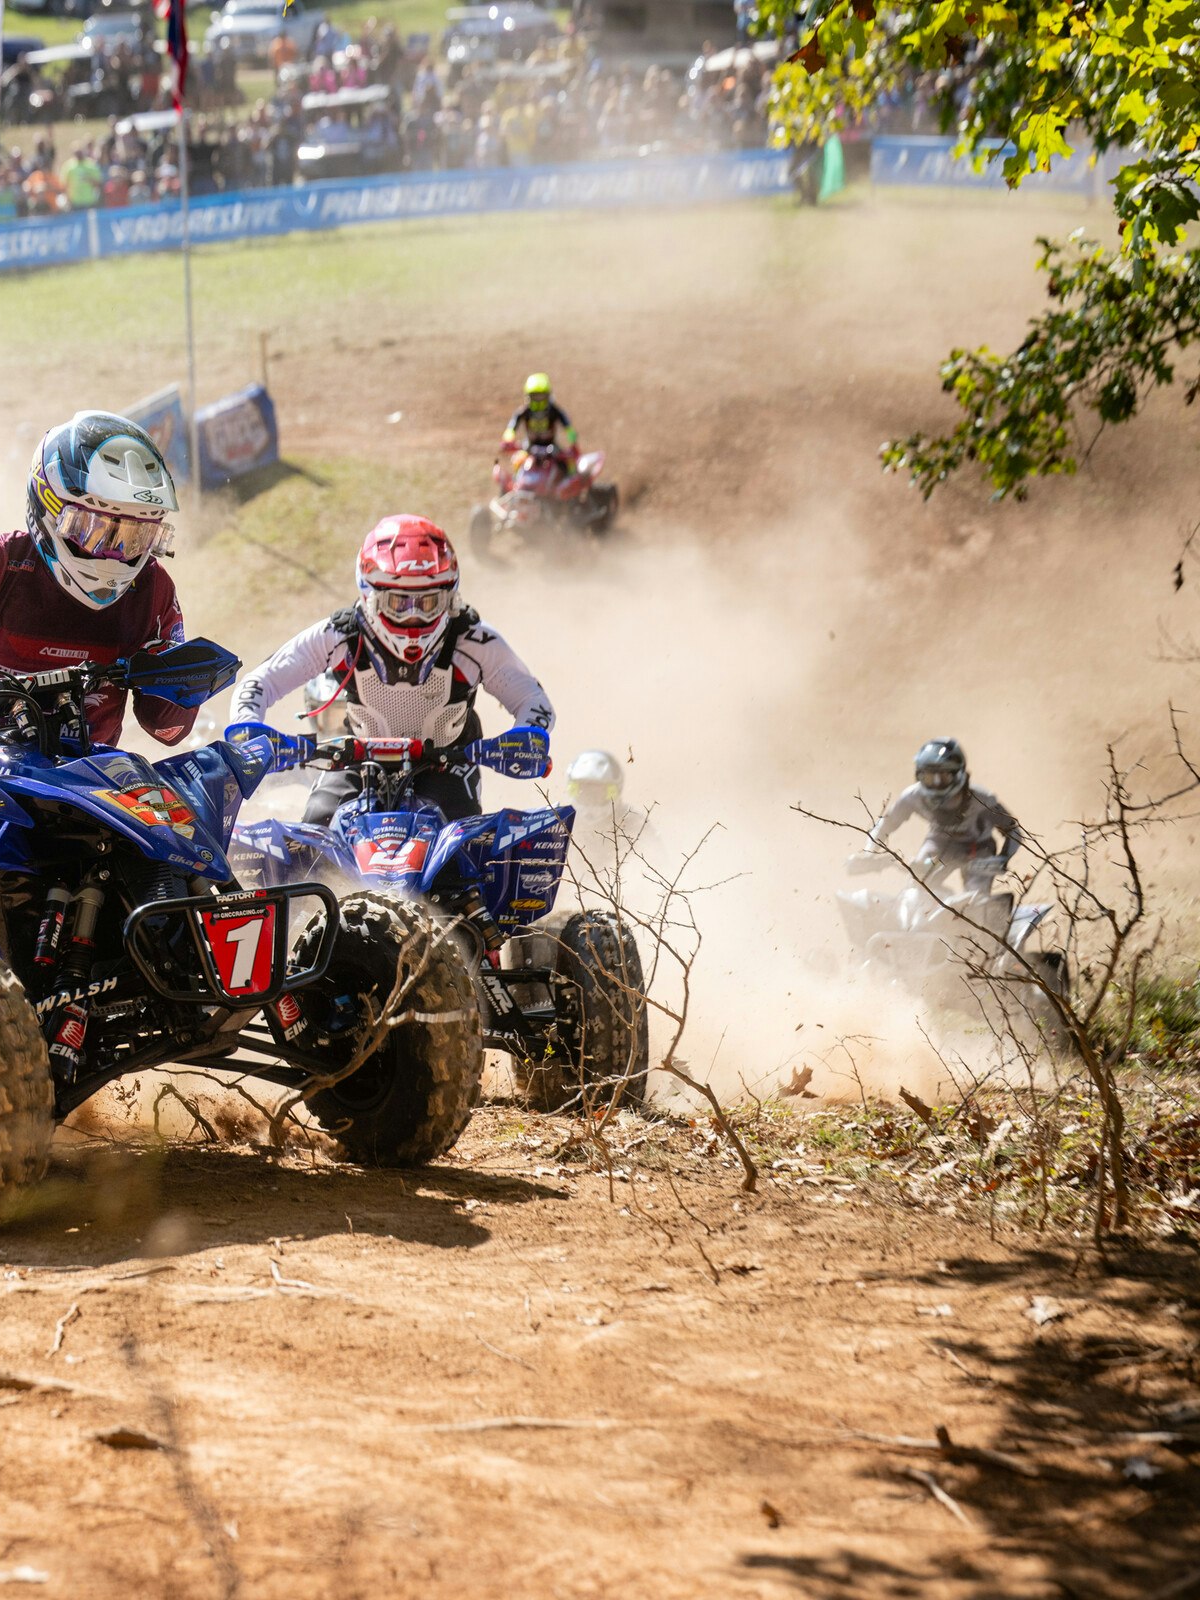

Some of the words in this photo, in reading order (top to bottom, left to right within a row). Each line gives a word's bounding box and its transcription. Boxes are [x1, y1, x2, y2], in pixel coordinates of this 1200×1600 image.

[395, 560, 437, 572] FLY
[464, 629, 497, 645] LY
[167, 852, 195, 867] Elka
[232, 852, 266, 861] KENDA
[367, 839, 416, 866] 2
[225, 918, 264, 990] 1
[36, 976, 118, 1015] WALSH
